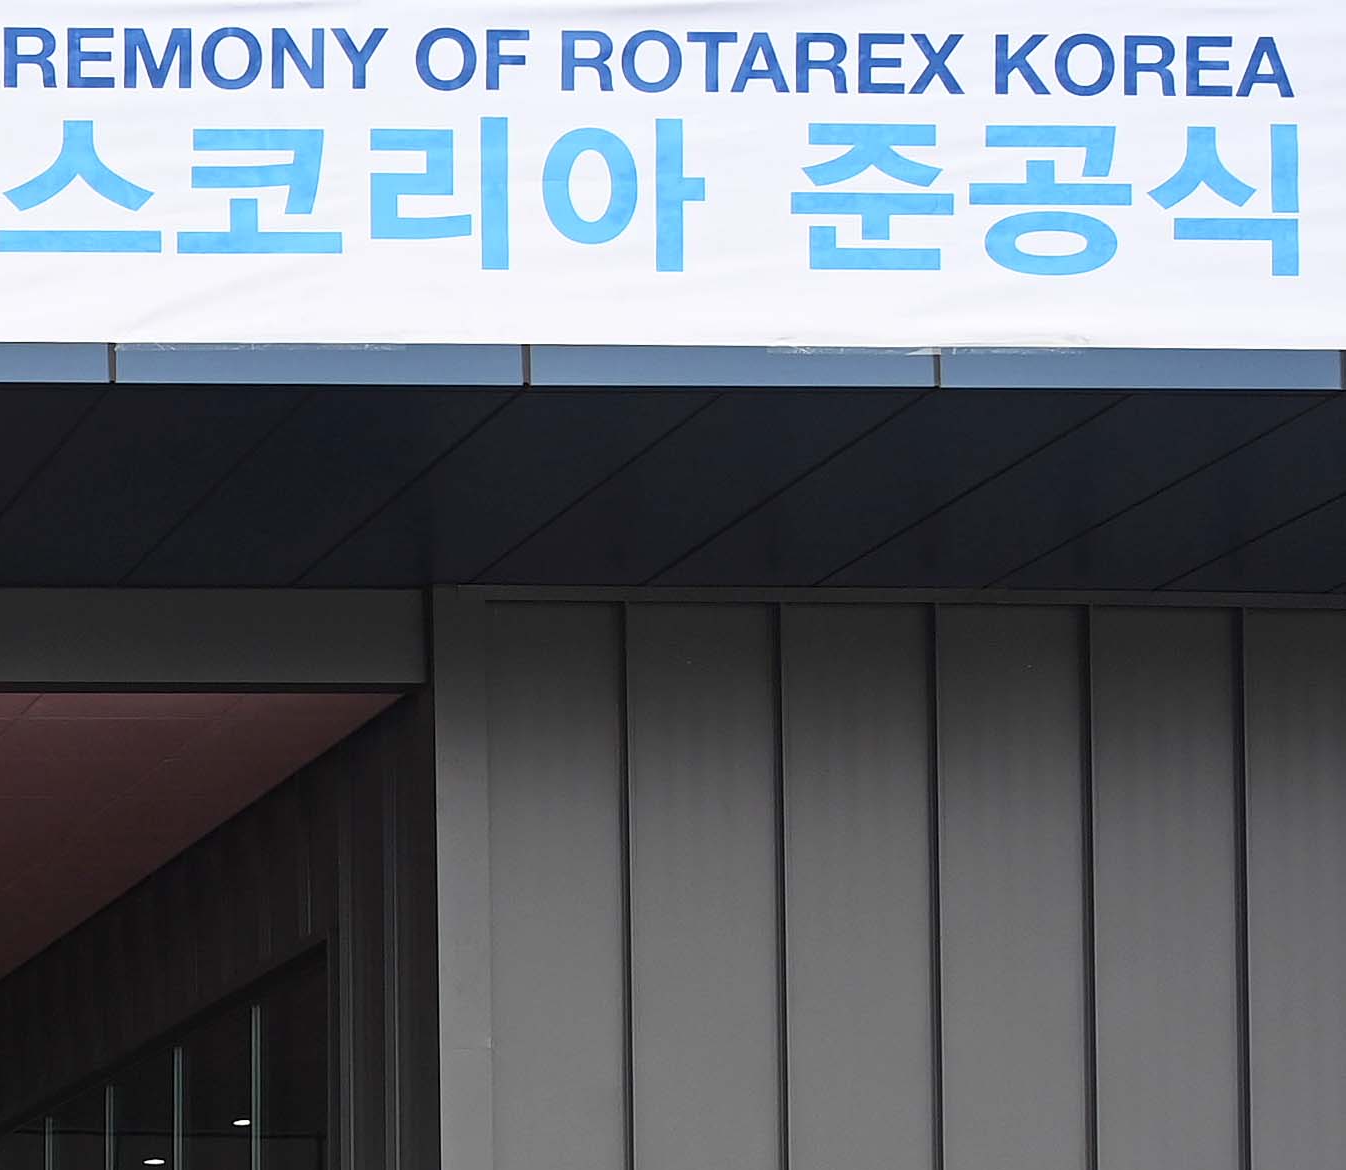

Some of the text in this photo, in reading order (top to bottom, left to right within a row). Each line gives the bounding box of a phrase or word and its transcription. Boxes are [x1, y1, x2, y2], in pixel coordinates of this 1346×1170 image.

[416, 28, 530, 93] OF
[561, 31, 965, 95] ROTAREX
[995, 34, 1295, 98] KOREA
[789, 123, 1302, 277] 준공식
